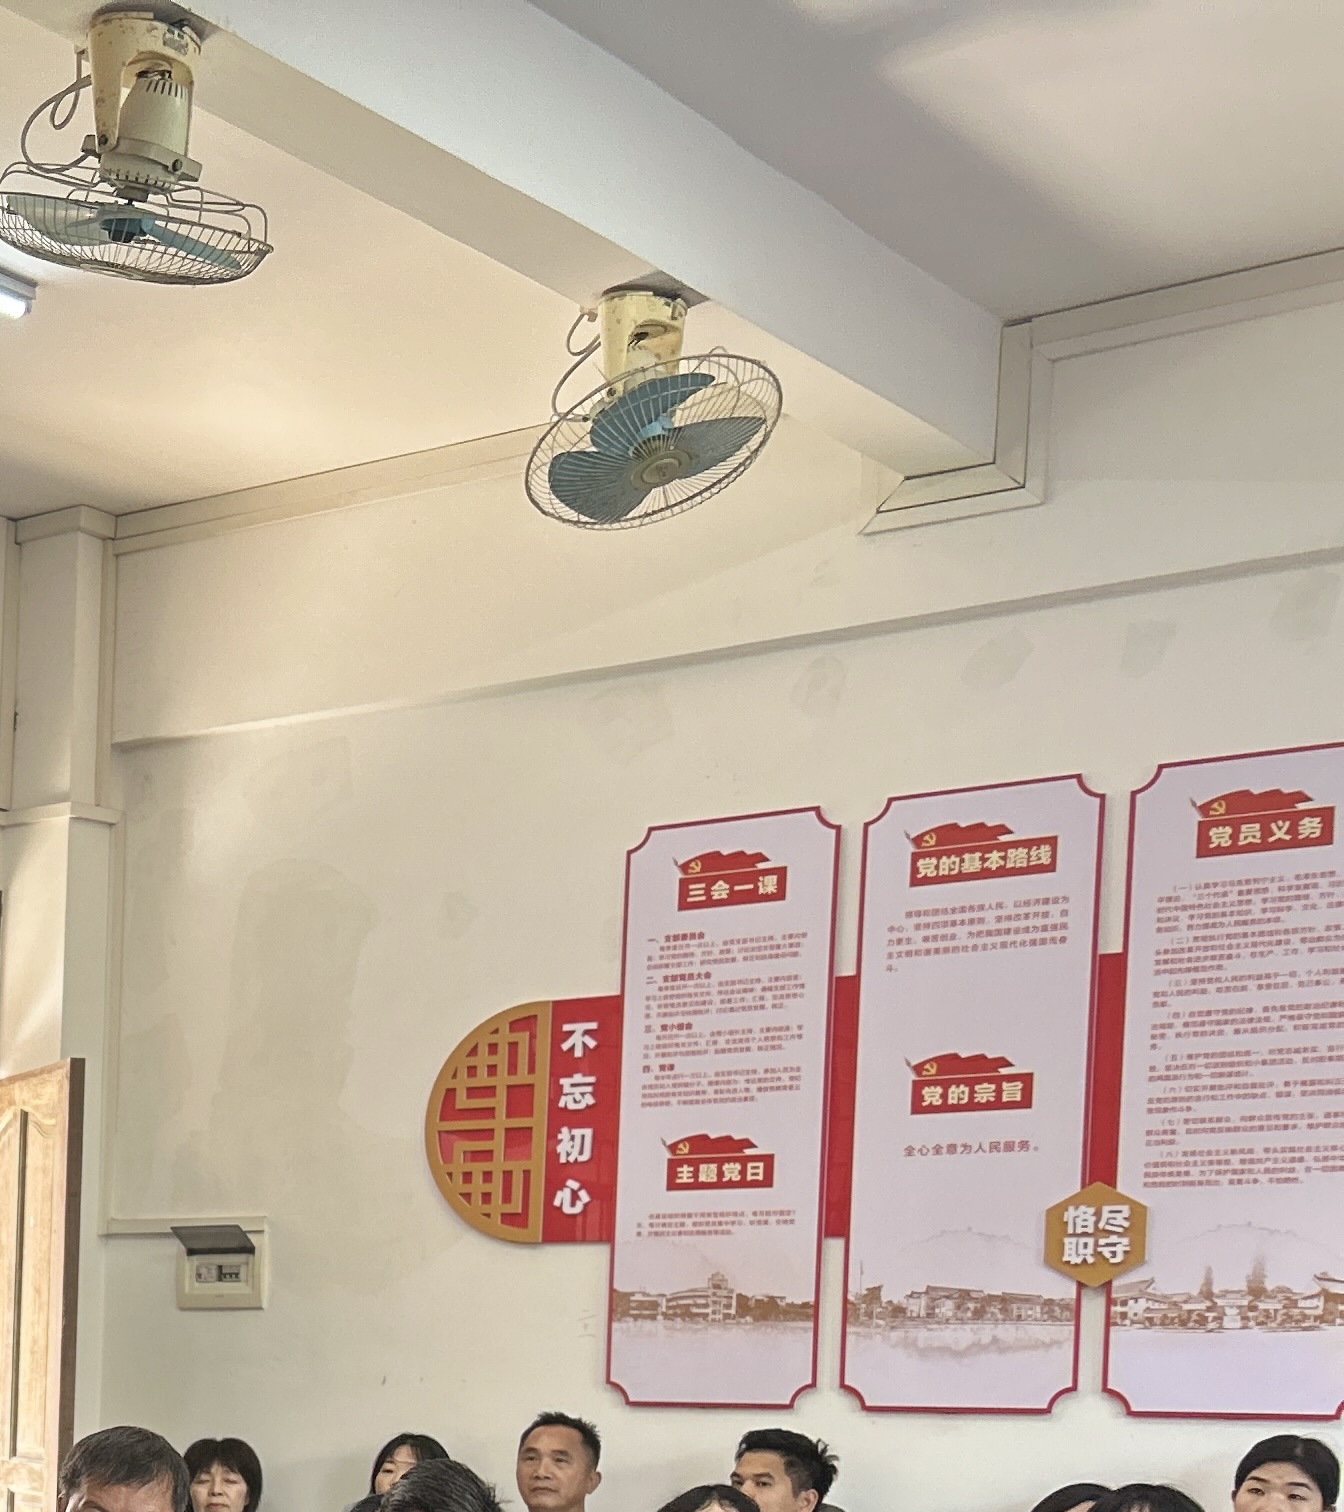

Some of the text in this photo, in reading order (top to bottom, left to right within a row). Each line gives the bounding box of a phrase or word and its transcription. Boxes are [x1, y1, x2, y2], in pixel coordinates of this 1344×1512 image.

[1209, 816, 1324, 849] 党员义务
[916, 844, 1053, 879] 党的基本路线
[686, 874, 779, 903] 三会一课
[921, 1081, 1024, 1107] 党的宗旨
[553, 1021, 600, 1216] 不忘初心
[675, 1162, 765, 1184] 主题党日
[1063, 1204, 1131, 1234] 恪尽
[1062, 1234, 1131, 1265] 职守
